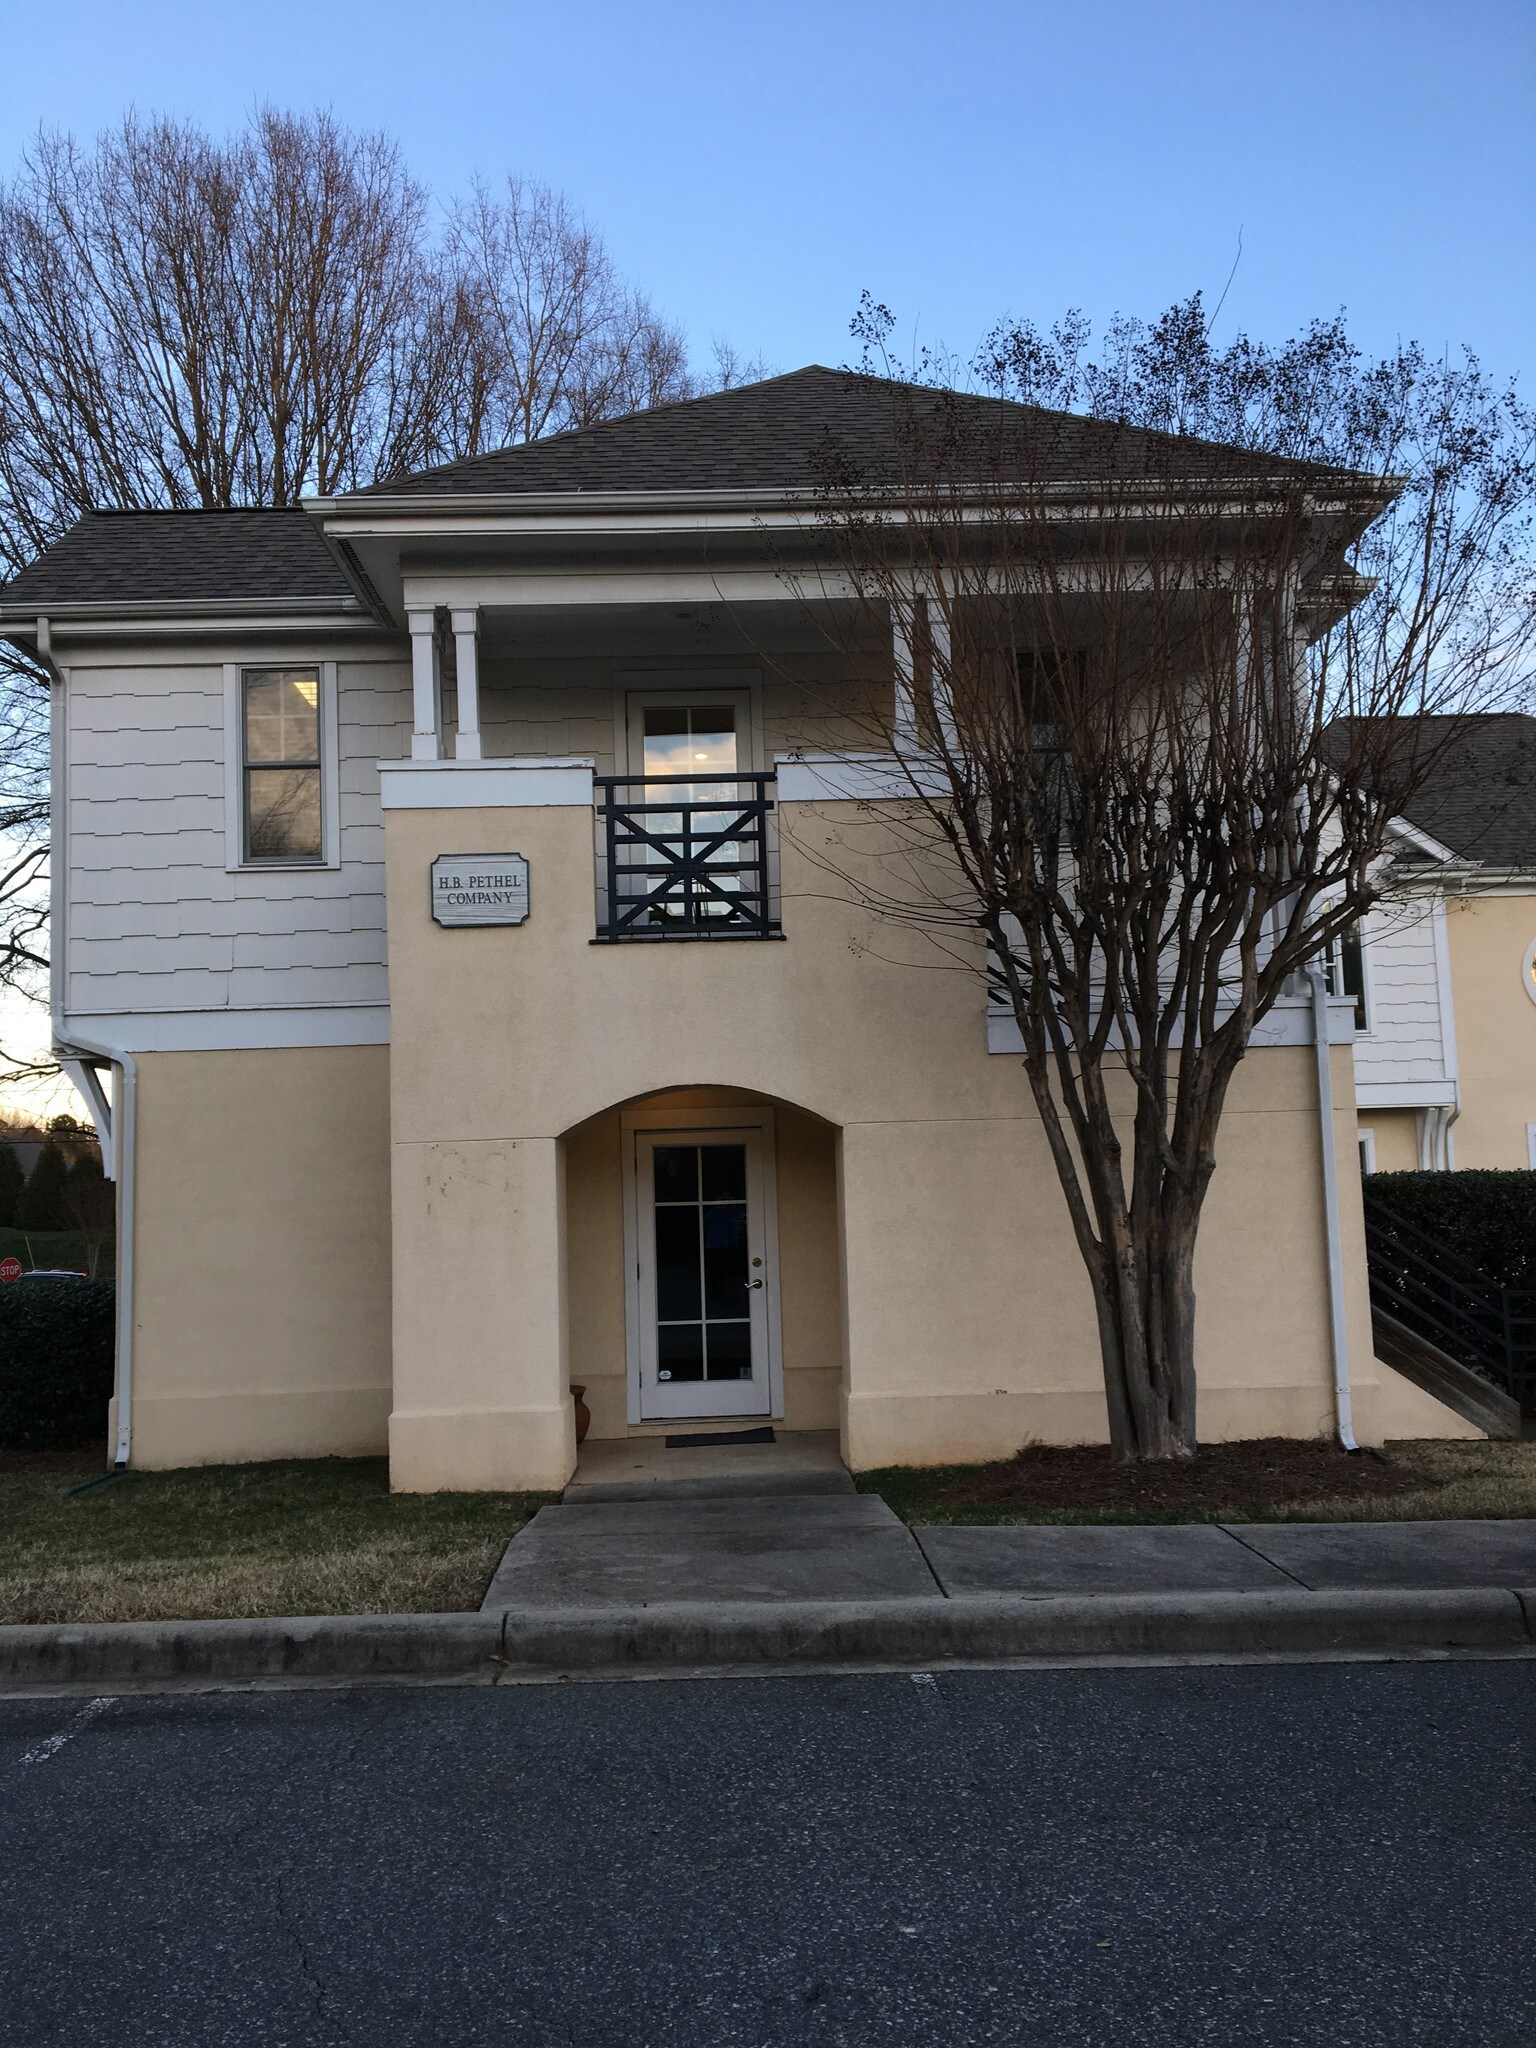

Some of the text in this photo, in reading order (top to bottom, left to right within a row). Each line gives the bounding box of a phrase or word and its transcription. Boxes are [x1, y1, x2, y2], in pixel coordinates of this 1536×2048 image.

[439, 875, 521, 889] H.B. PETHEL
[447, 892, 512, 904] COMPANY
[0, 1265, 19, 1275] STOP
